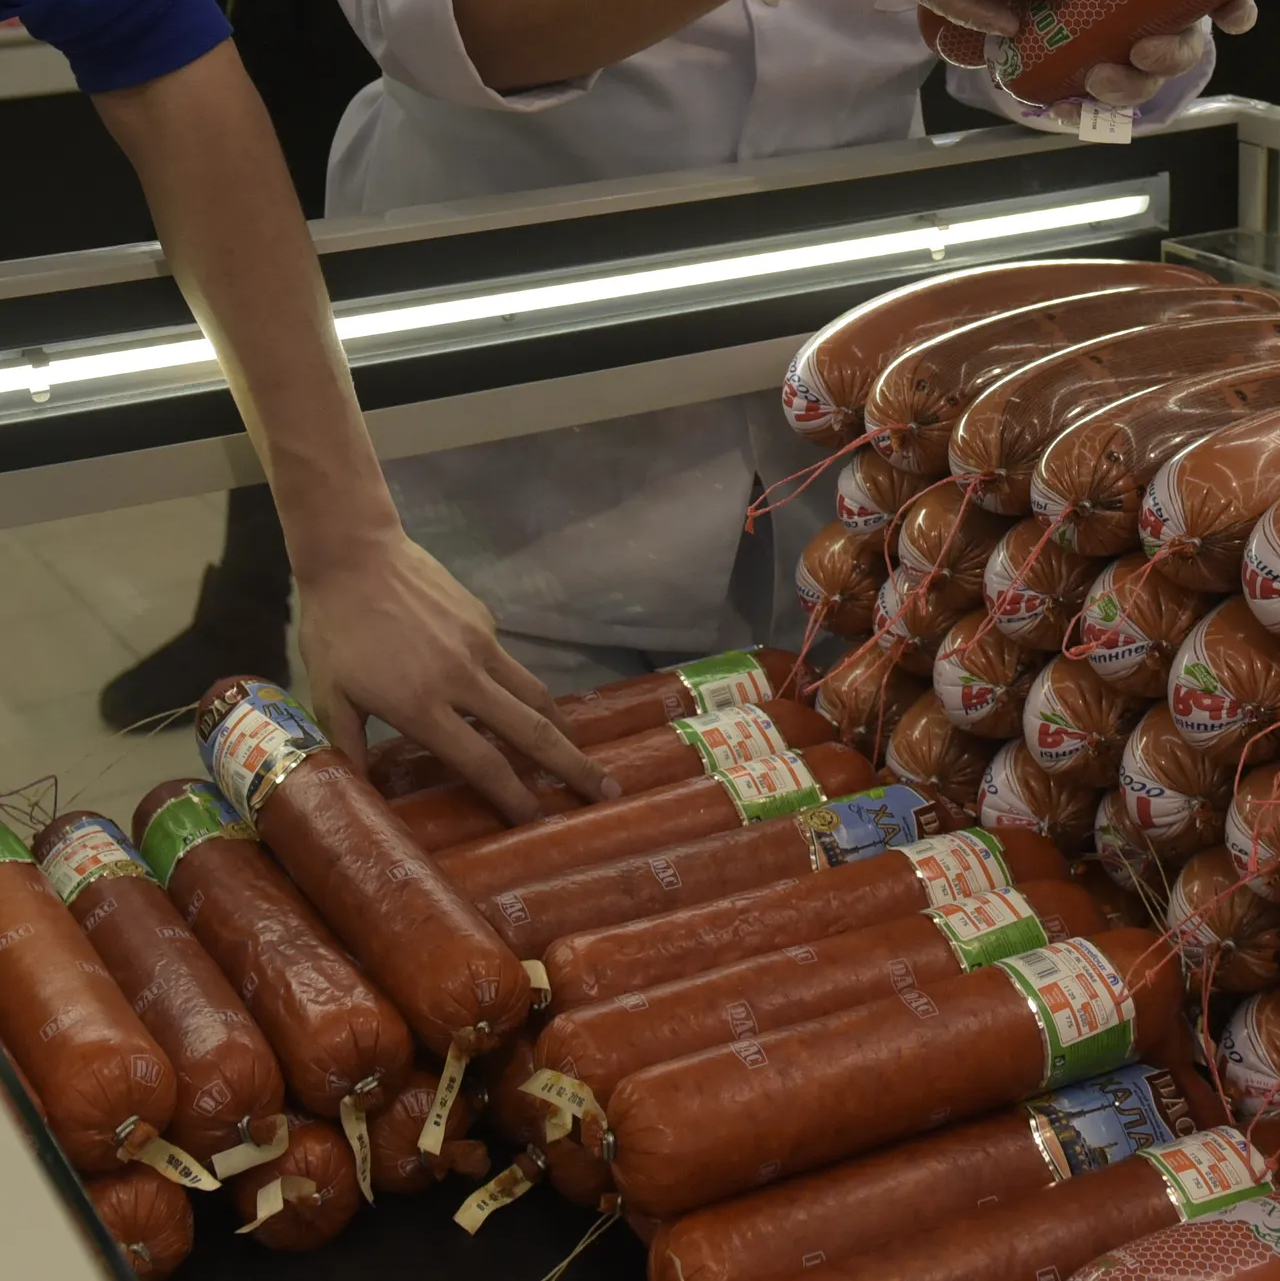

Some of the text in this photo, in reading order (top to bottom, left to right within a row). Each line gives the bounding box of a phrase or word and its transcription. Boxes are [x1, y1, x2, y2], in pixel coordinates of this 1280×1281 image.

[650, 857, 679, 888] DAC
[1072, 939, 1107, 973] Carrefour
[1096, 1076, 1156, 1154] ХАЛА
